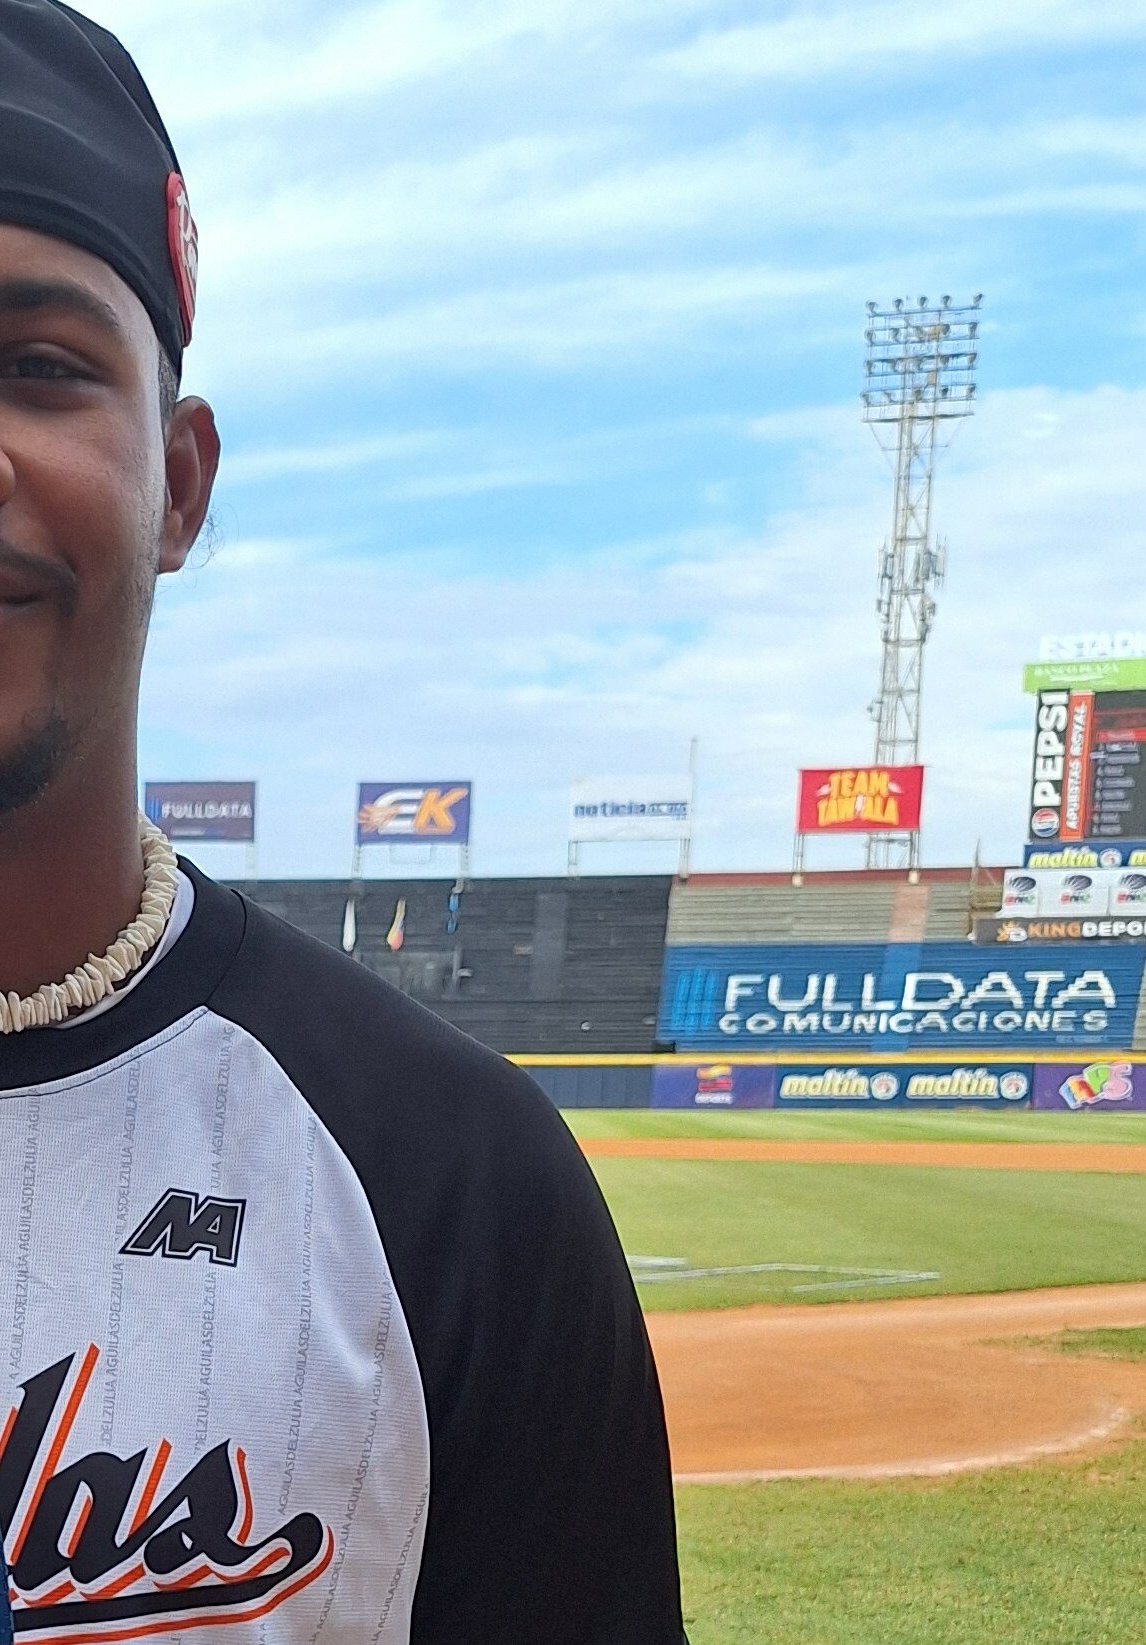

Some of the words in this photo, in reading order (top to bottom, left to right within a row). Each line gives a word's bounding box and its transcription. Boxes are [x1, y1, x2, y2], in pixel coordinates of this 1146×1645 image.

[1033, 691, 1068, 807] PEPSI
[828, 770, 890, 798] TEAM
[162, 801, 252, 818] FULLDATA
[1028, 921, 1146, 938] KINGDEPO
[725, 970, 1117, 1012] FULLDATA
[719, 1009, 1108, 1035] COMUNICACIONES
